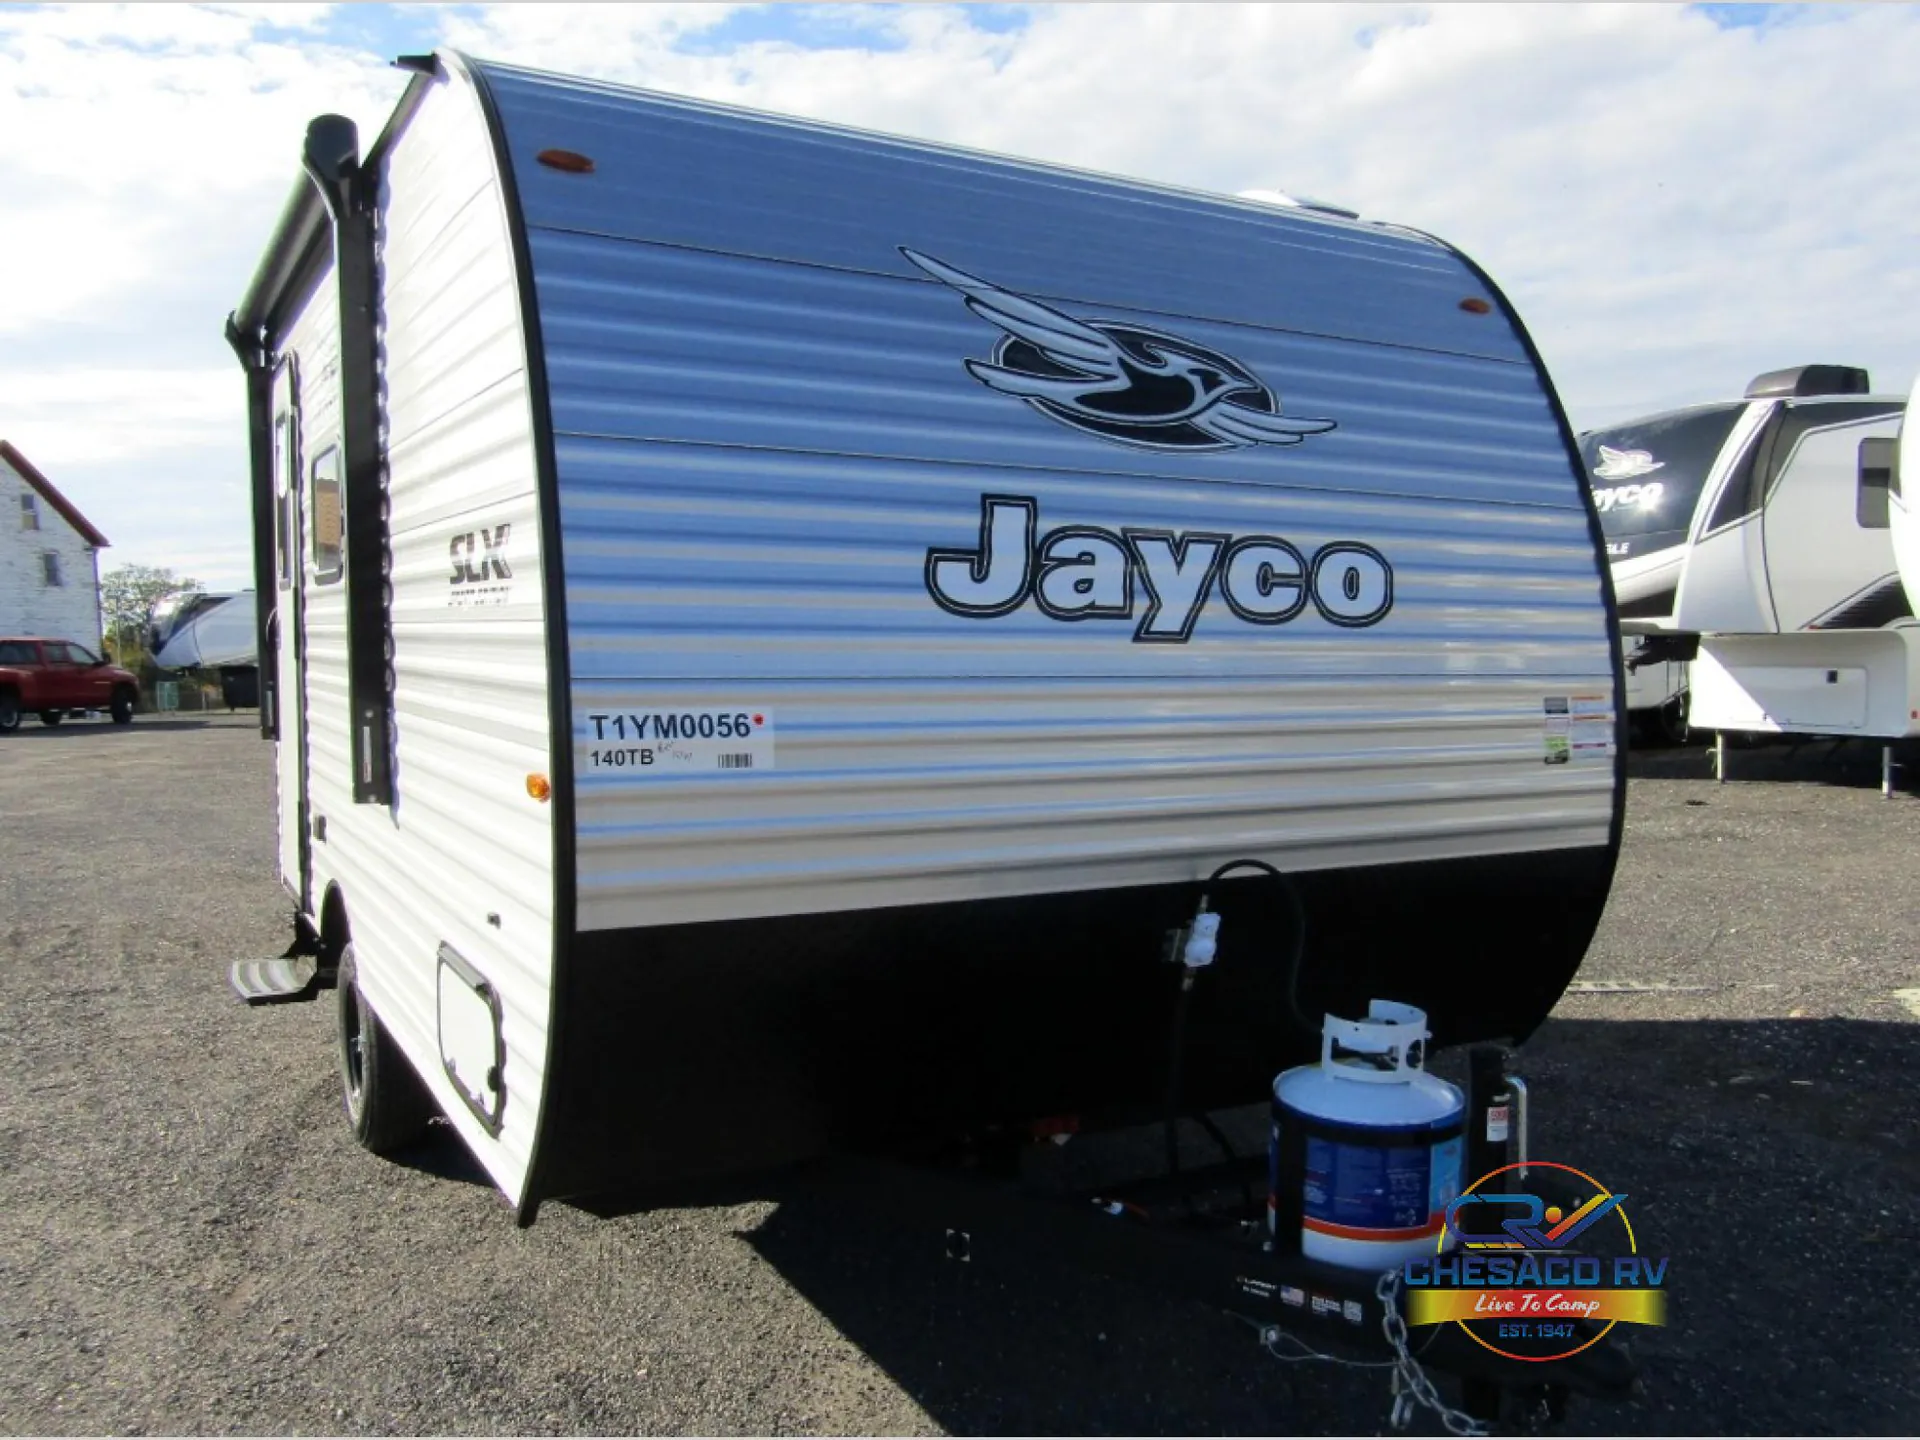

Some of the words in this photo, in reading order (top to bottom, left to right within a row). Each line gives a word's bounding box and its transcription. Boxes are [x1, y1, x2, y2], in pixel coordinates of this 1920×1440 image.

[1590, 482, 1664, 512] ayco
[449, 523, 513, 585] SLX
[923, 493, 1394, 643] Jayco
[589, 712, 751, 741] T1YM0056
[590, 748, 654, 767] 140TB
